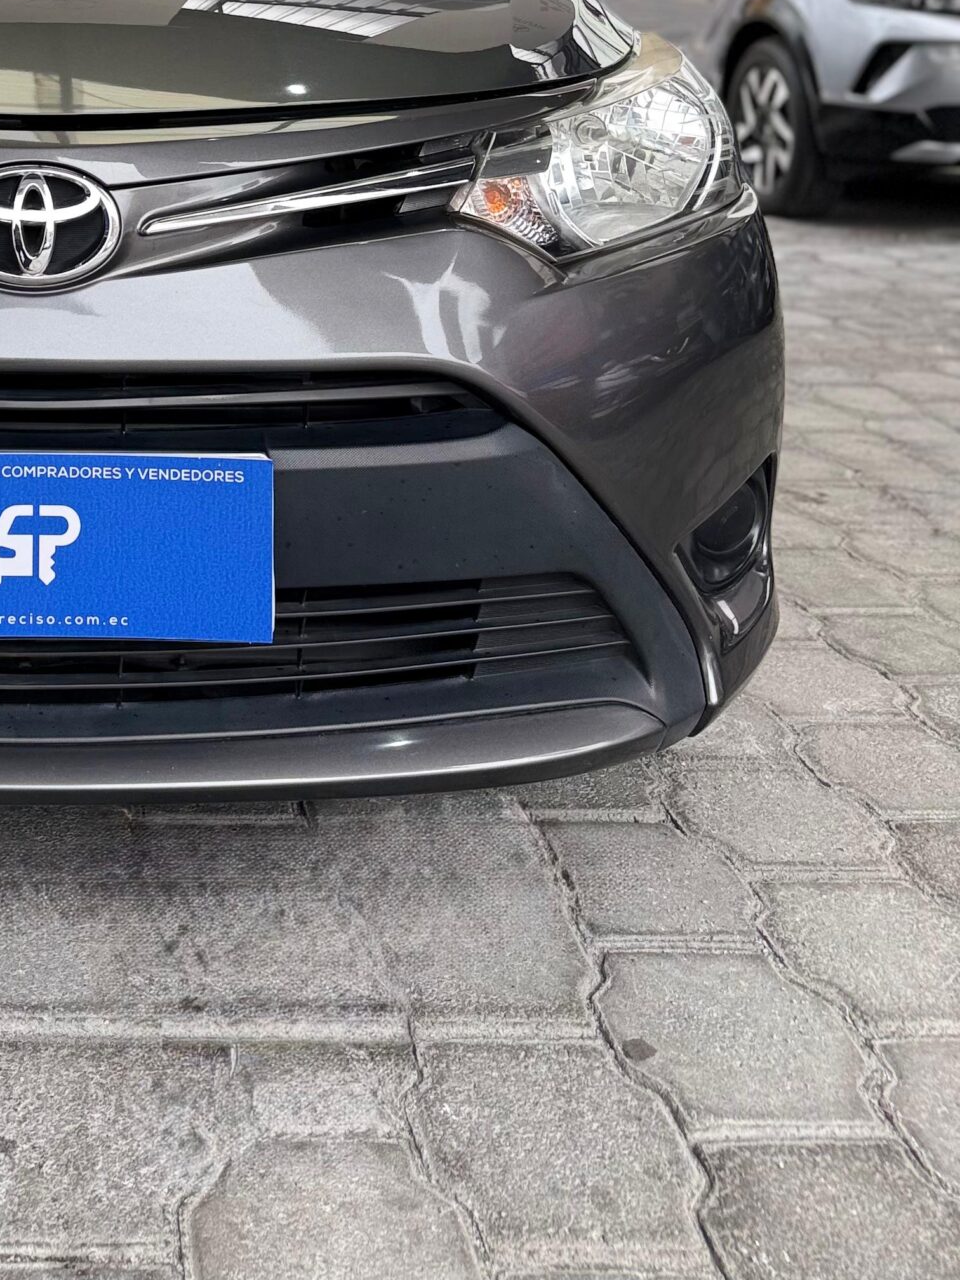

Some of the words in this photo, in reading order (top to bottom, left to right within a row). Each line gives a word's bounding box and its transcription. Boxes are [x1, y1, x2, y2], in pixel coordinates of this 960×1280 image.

[1, 465, 122, 480] COMPRADORES
[125, 468, 136, 480] Y
[137, 468, 245, 483] VENDEDORES
